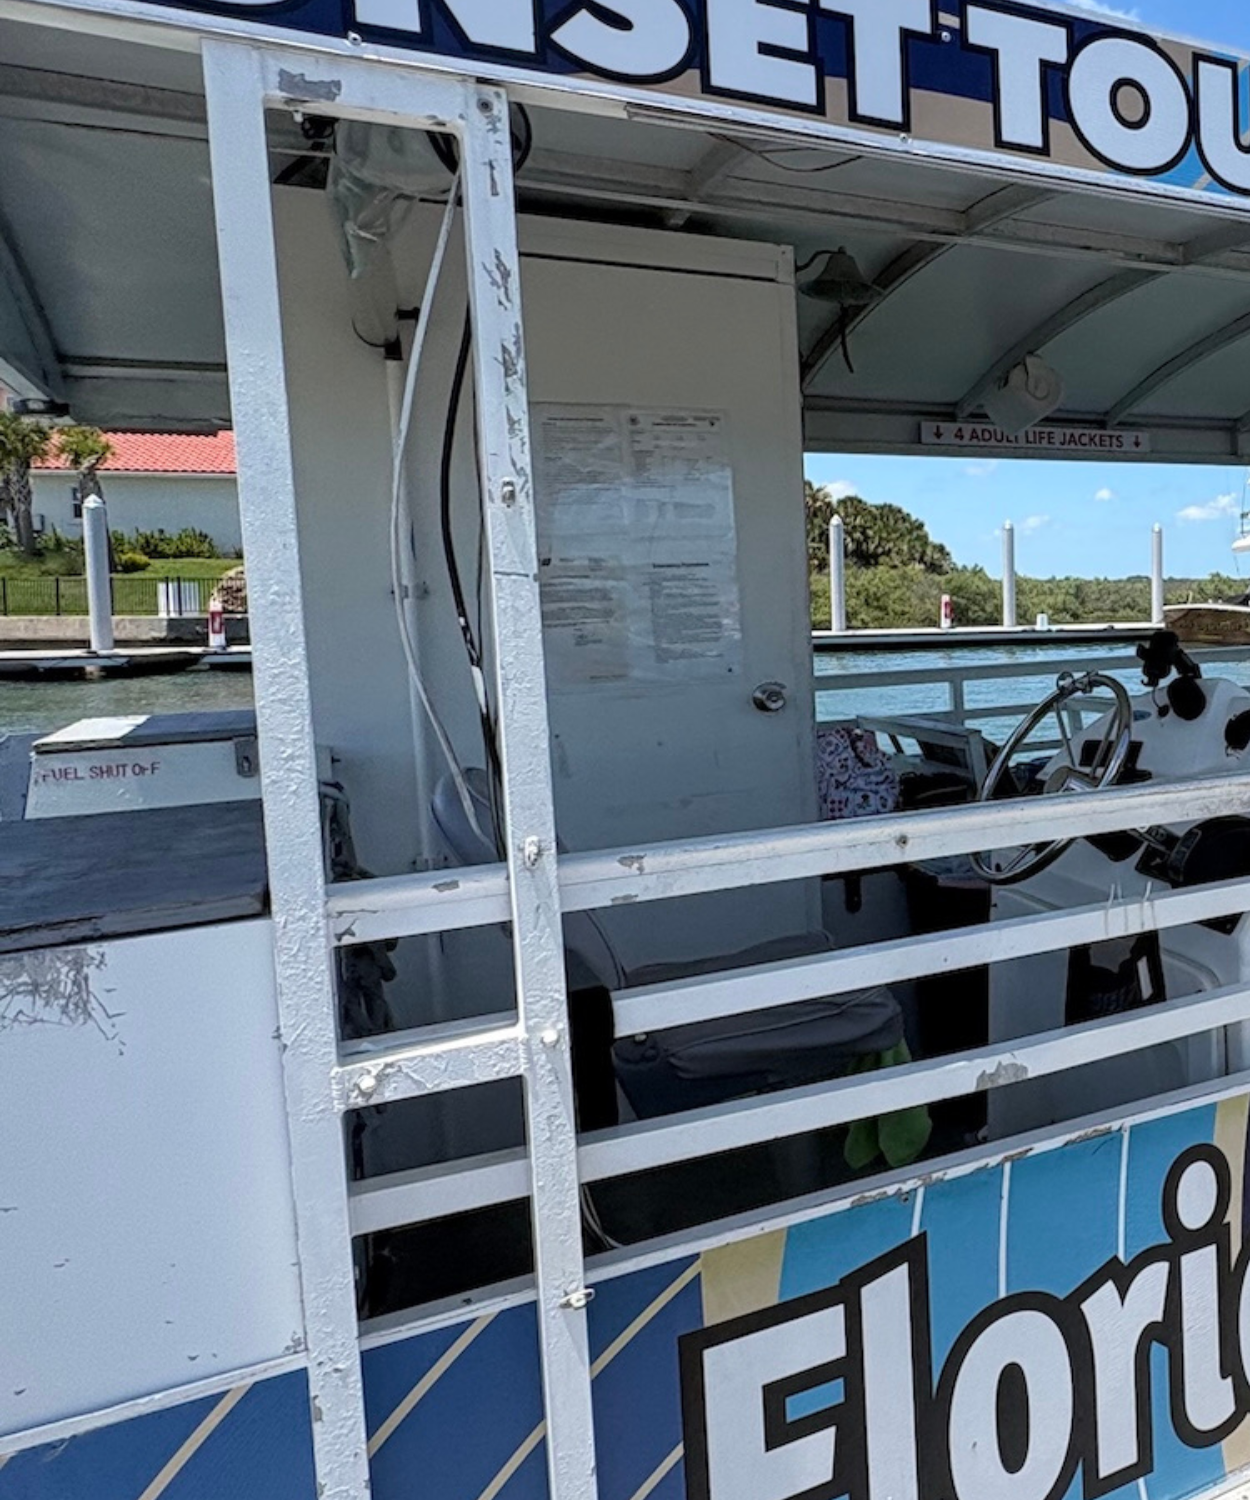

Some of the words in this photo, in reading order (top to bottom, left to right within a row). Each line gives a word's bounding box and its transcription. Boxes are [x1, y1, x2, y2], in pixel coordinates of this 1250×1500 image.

[953, 427, 965, 441] 4
[1025, 430, 1055, 446] LIFE
[1059, 432, 1124, 449] JACKETS
[89, 763, 128, 780] SHUT
